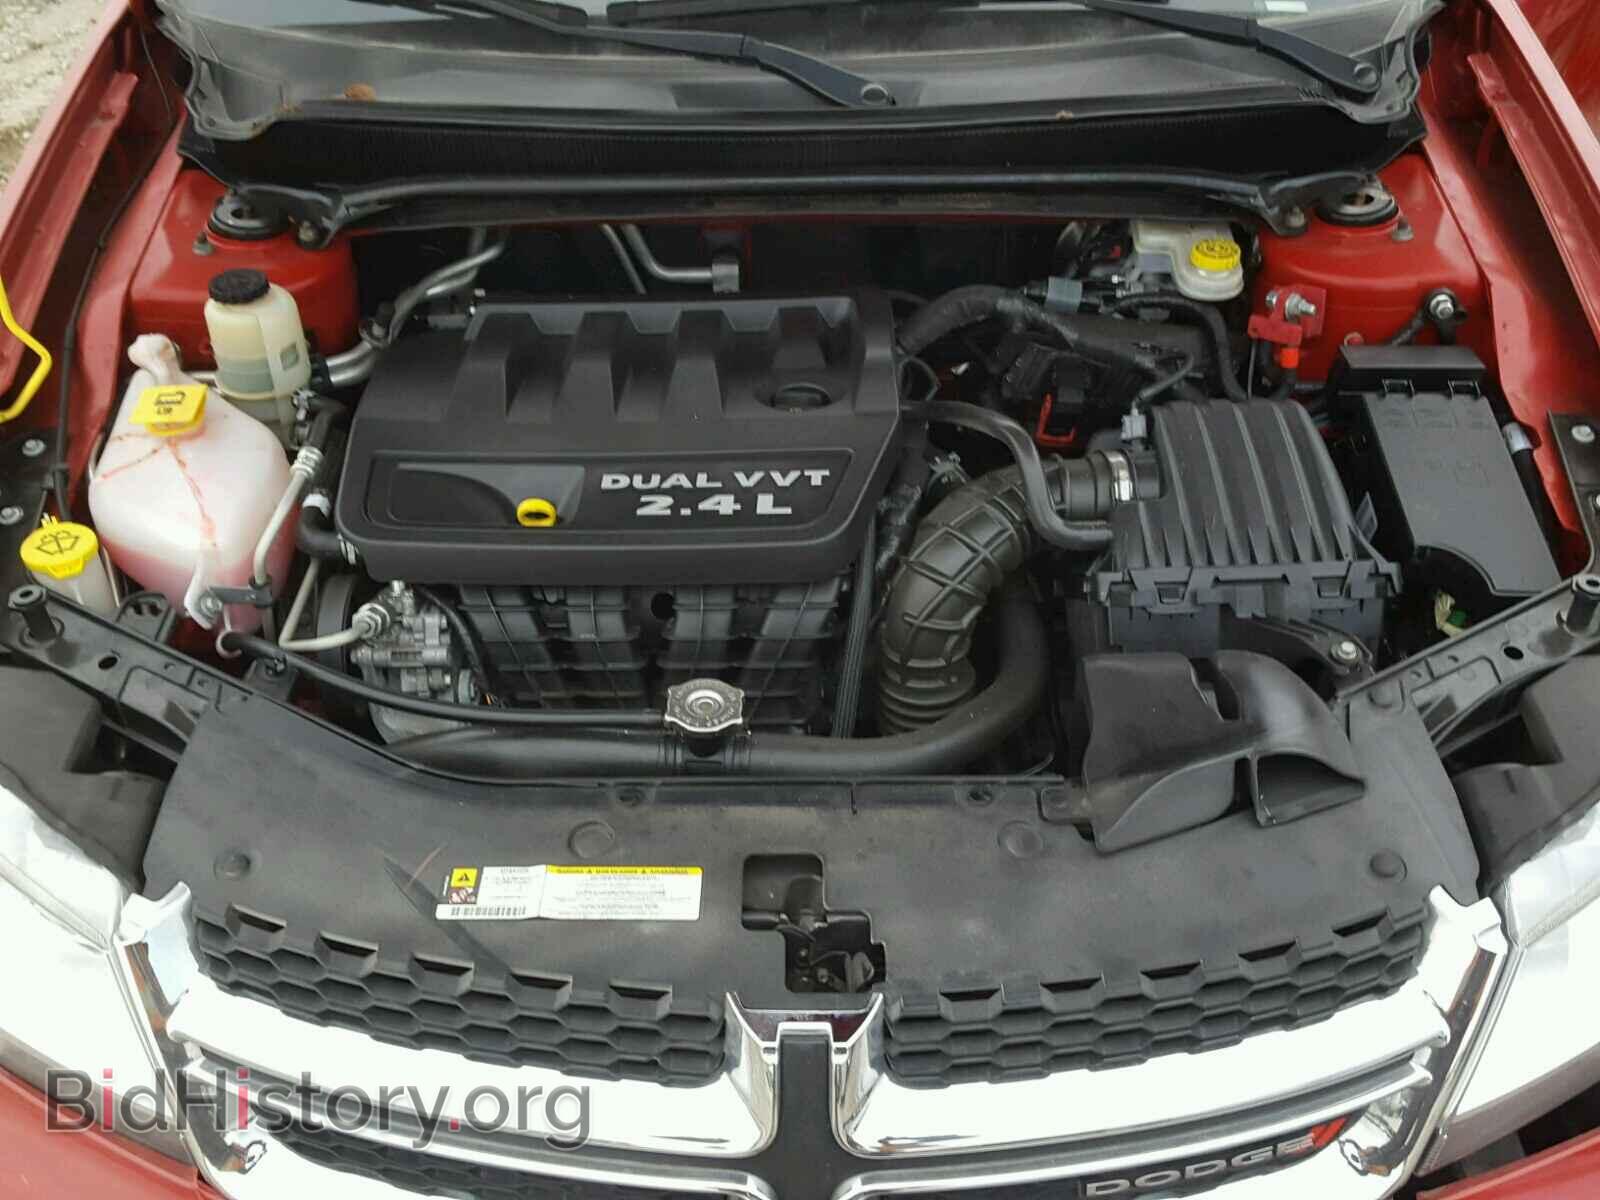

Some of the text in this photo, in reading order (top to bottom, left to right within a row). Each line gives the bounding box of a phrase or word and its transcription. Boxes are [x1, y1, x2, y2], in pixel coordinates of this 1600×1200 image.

[601, 469, 831, 490] DUAL VVT
[1086, 1133, 1315, 1198] DODGE
